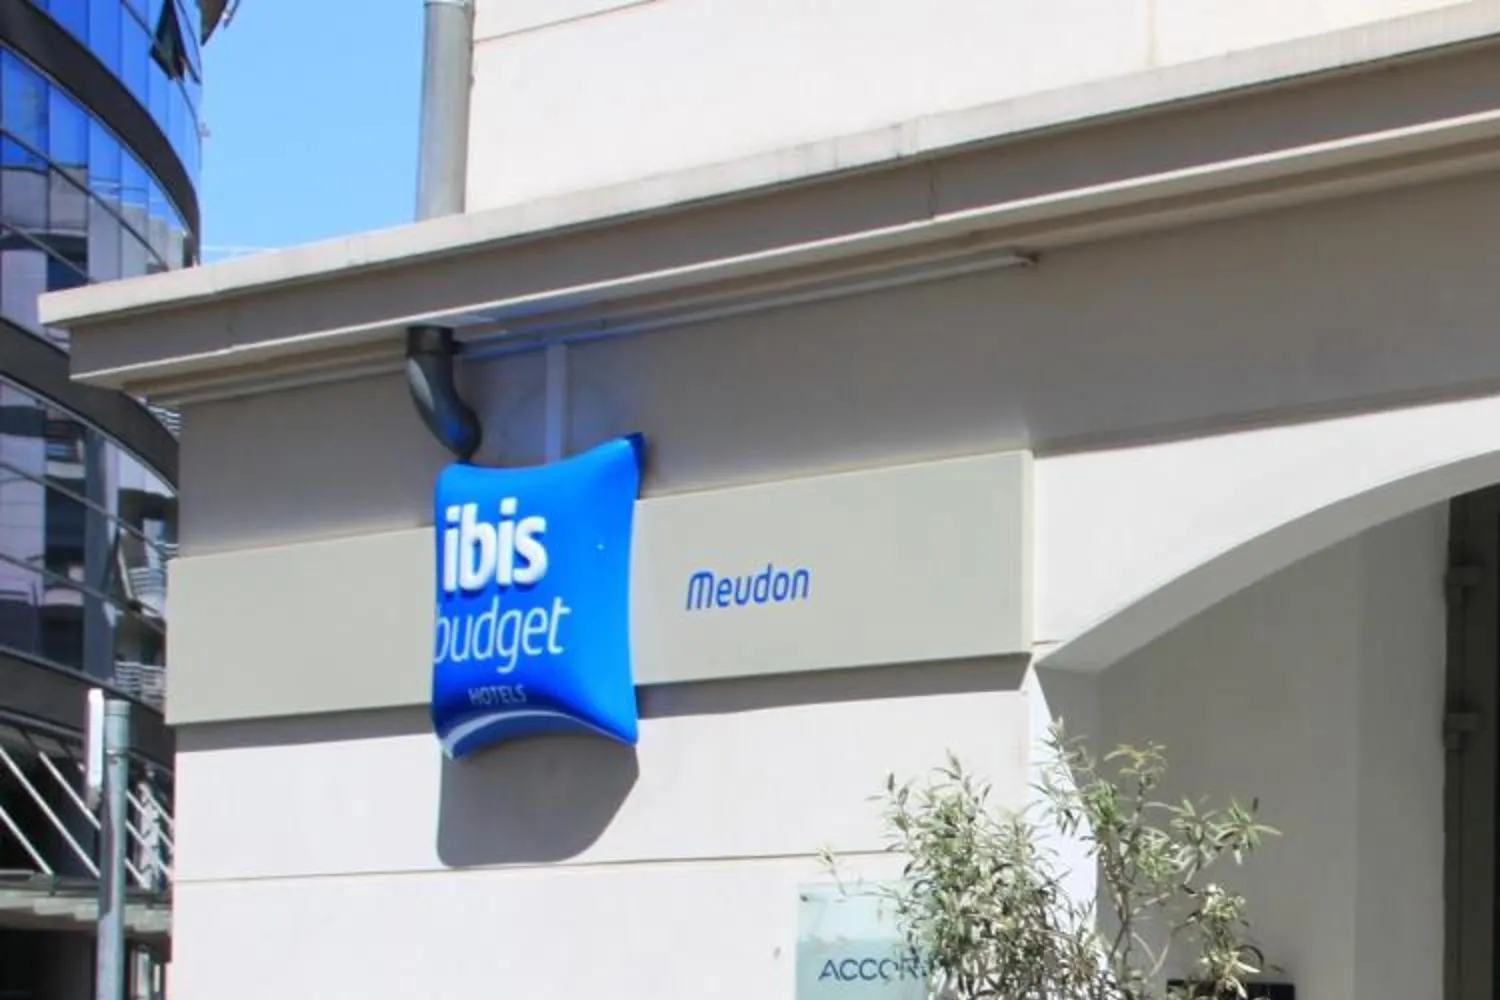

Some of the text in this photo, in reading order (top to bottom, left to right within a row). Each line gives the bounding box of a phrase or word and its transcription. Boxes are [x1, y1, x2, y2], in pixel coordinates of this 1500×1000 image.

[443, 496, 548, 592] ibis
[686, 563, 809, 611] Meudon
[468, 684, 527, 705] HOTELS
